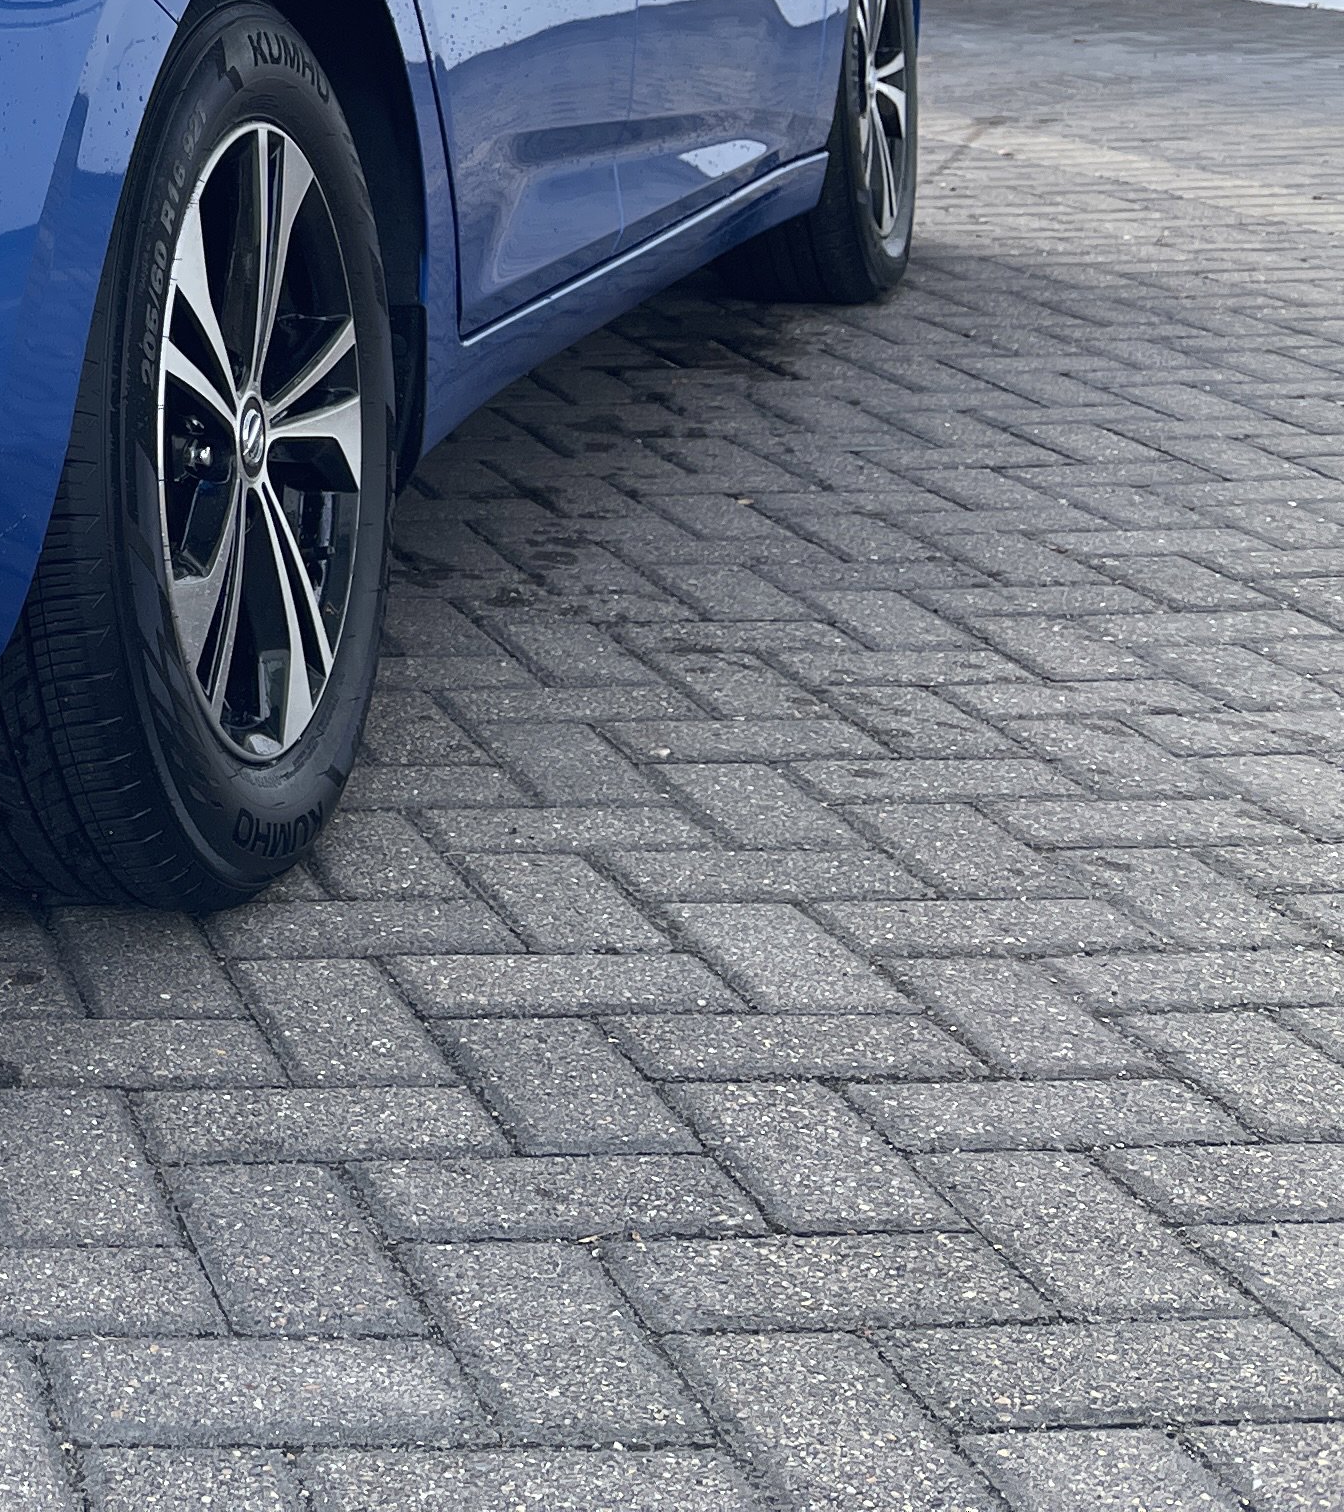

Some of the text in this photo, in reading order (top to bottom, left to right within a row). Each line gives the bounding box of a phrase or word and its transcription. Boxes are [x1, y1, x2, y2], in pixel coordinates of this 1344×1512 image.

[247, 29, 330, 104] KUMHO
[140, 239, 168, 391] 205/60
[160, 159, 186, 236] R16
[232, 800, 324, 859] KUMHO
